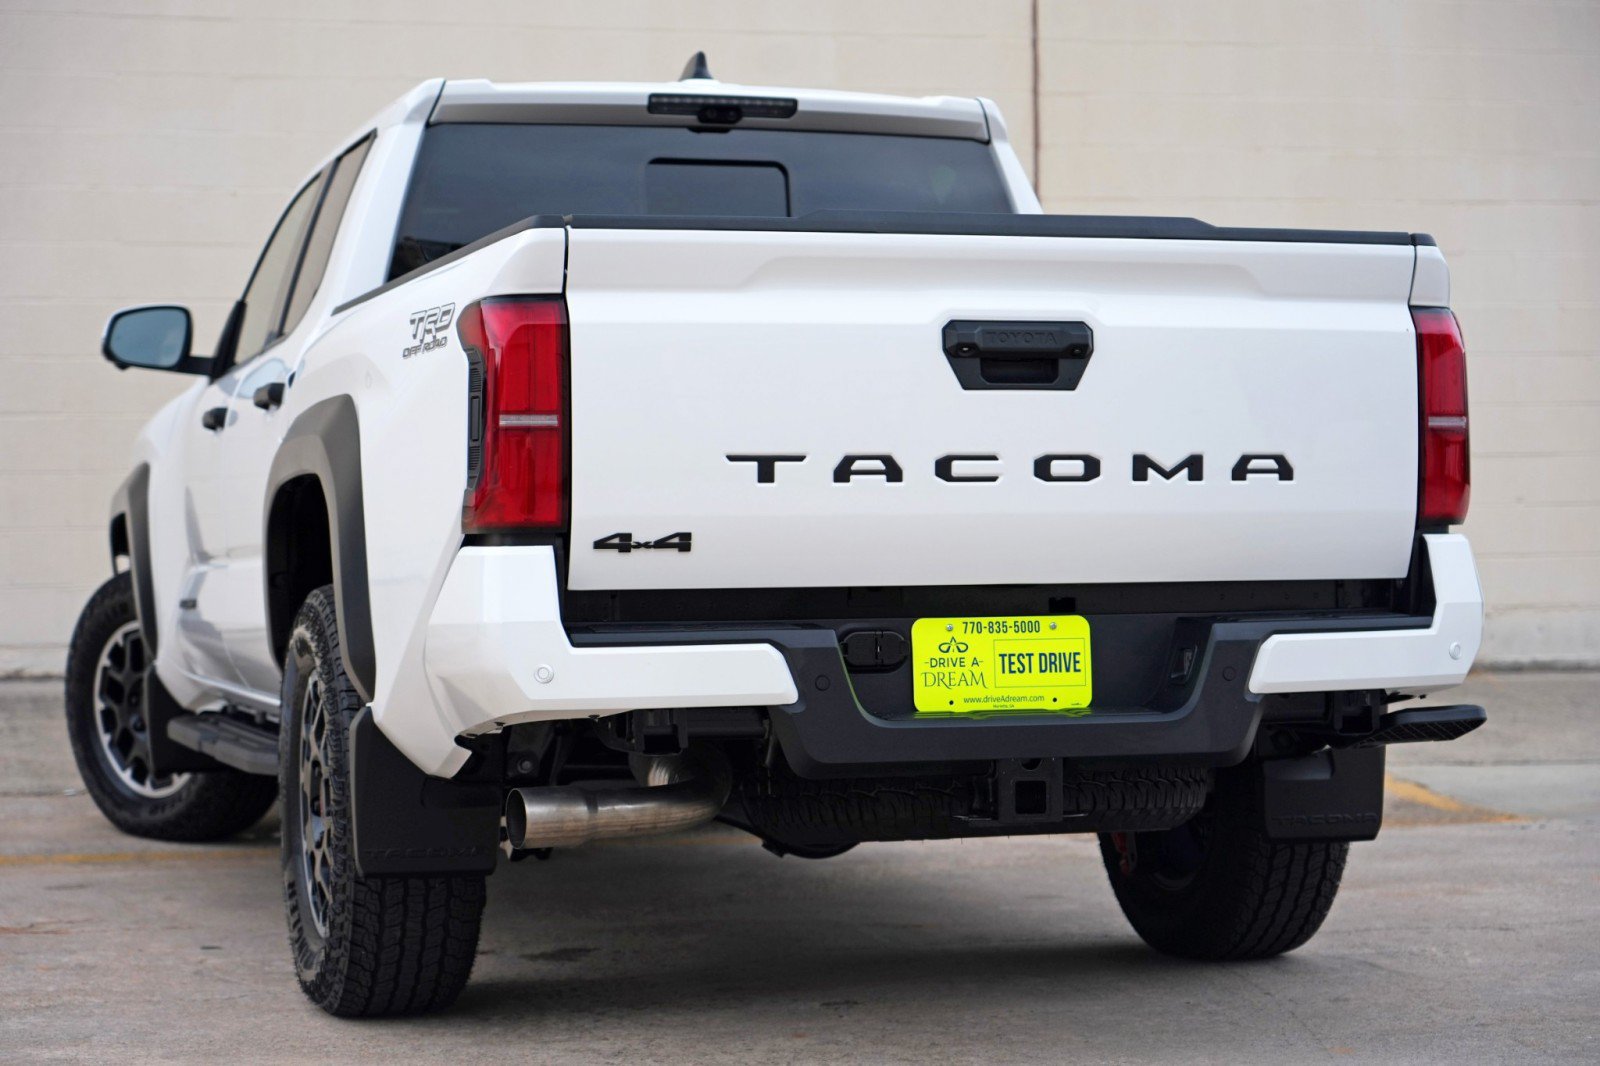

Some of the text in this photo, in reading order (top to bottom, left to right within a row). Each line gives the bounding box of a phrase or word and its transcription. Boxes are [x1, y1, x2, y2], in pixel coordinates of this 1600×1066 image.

[409, 302, 455, 346] TRD
[423, 336, 448, 353] ROAD
[986, 331, 1058, 345] TOYOTA
[726, 454, 1294, 483] TACOMA
[962, 620, 1041, 634] 770-835-5000
[999, 652, 1082, 674] TEST DRIVE
[921, 669, 989, 690] DREAM
[963, 694, 1045, 704] www.driveAdream.com
